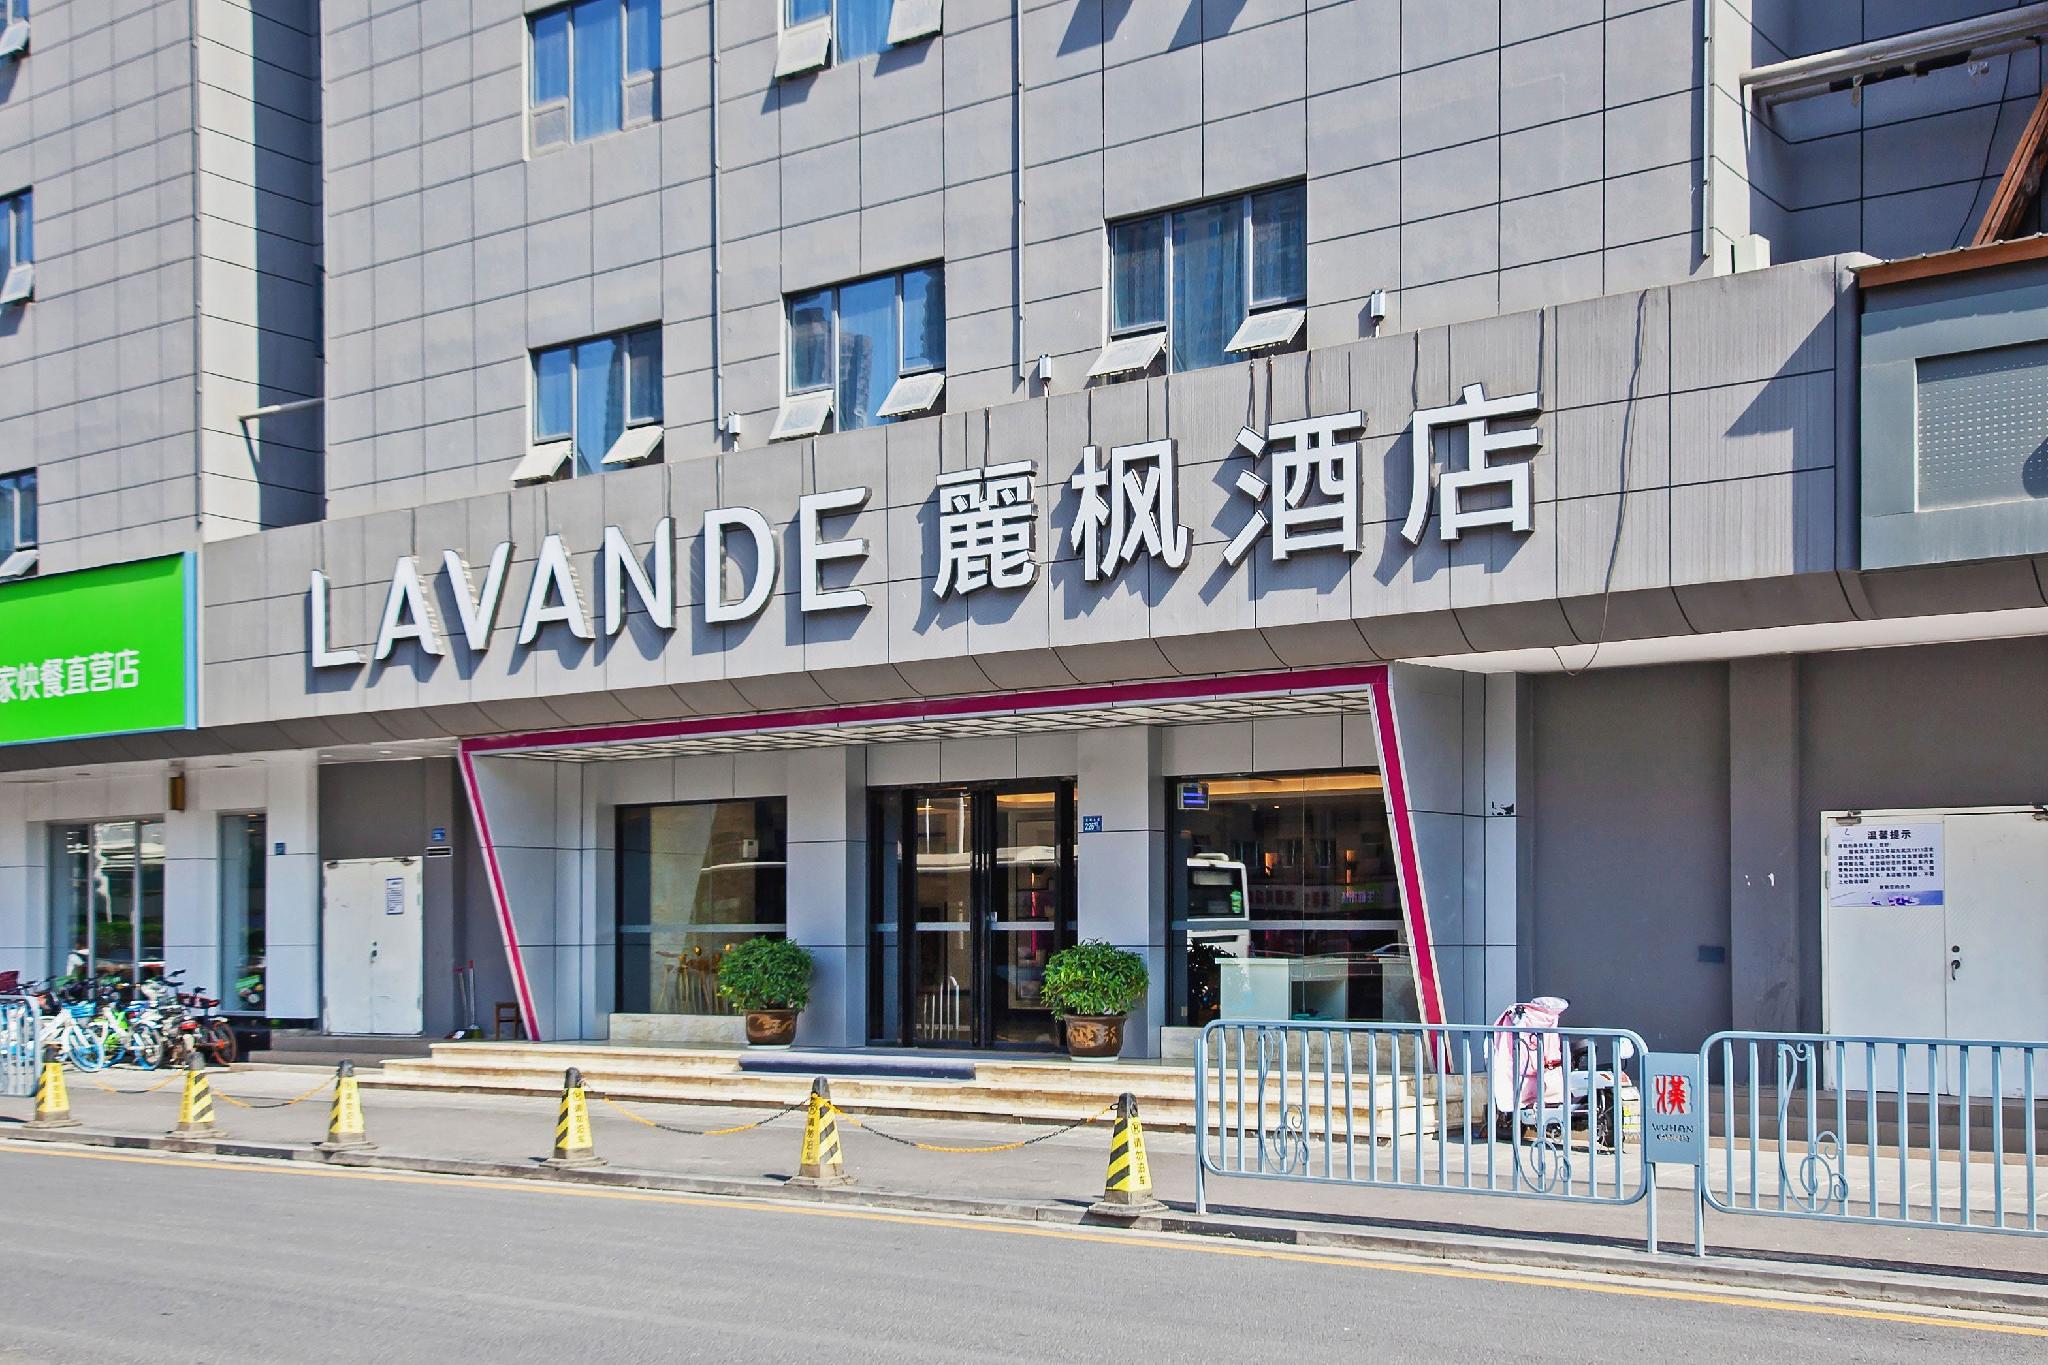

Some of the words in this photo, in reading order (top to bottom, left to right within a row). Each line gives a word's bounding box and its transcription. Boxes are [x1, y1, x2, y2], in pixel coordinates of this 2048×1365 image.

[311, 486, 872, 669] LAVANDE
[932, 382, 1543, 600] 麗枫酒店
